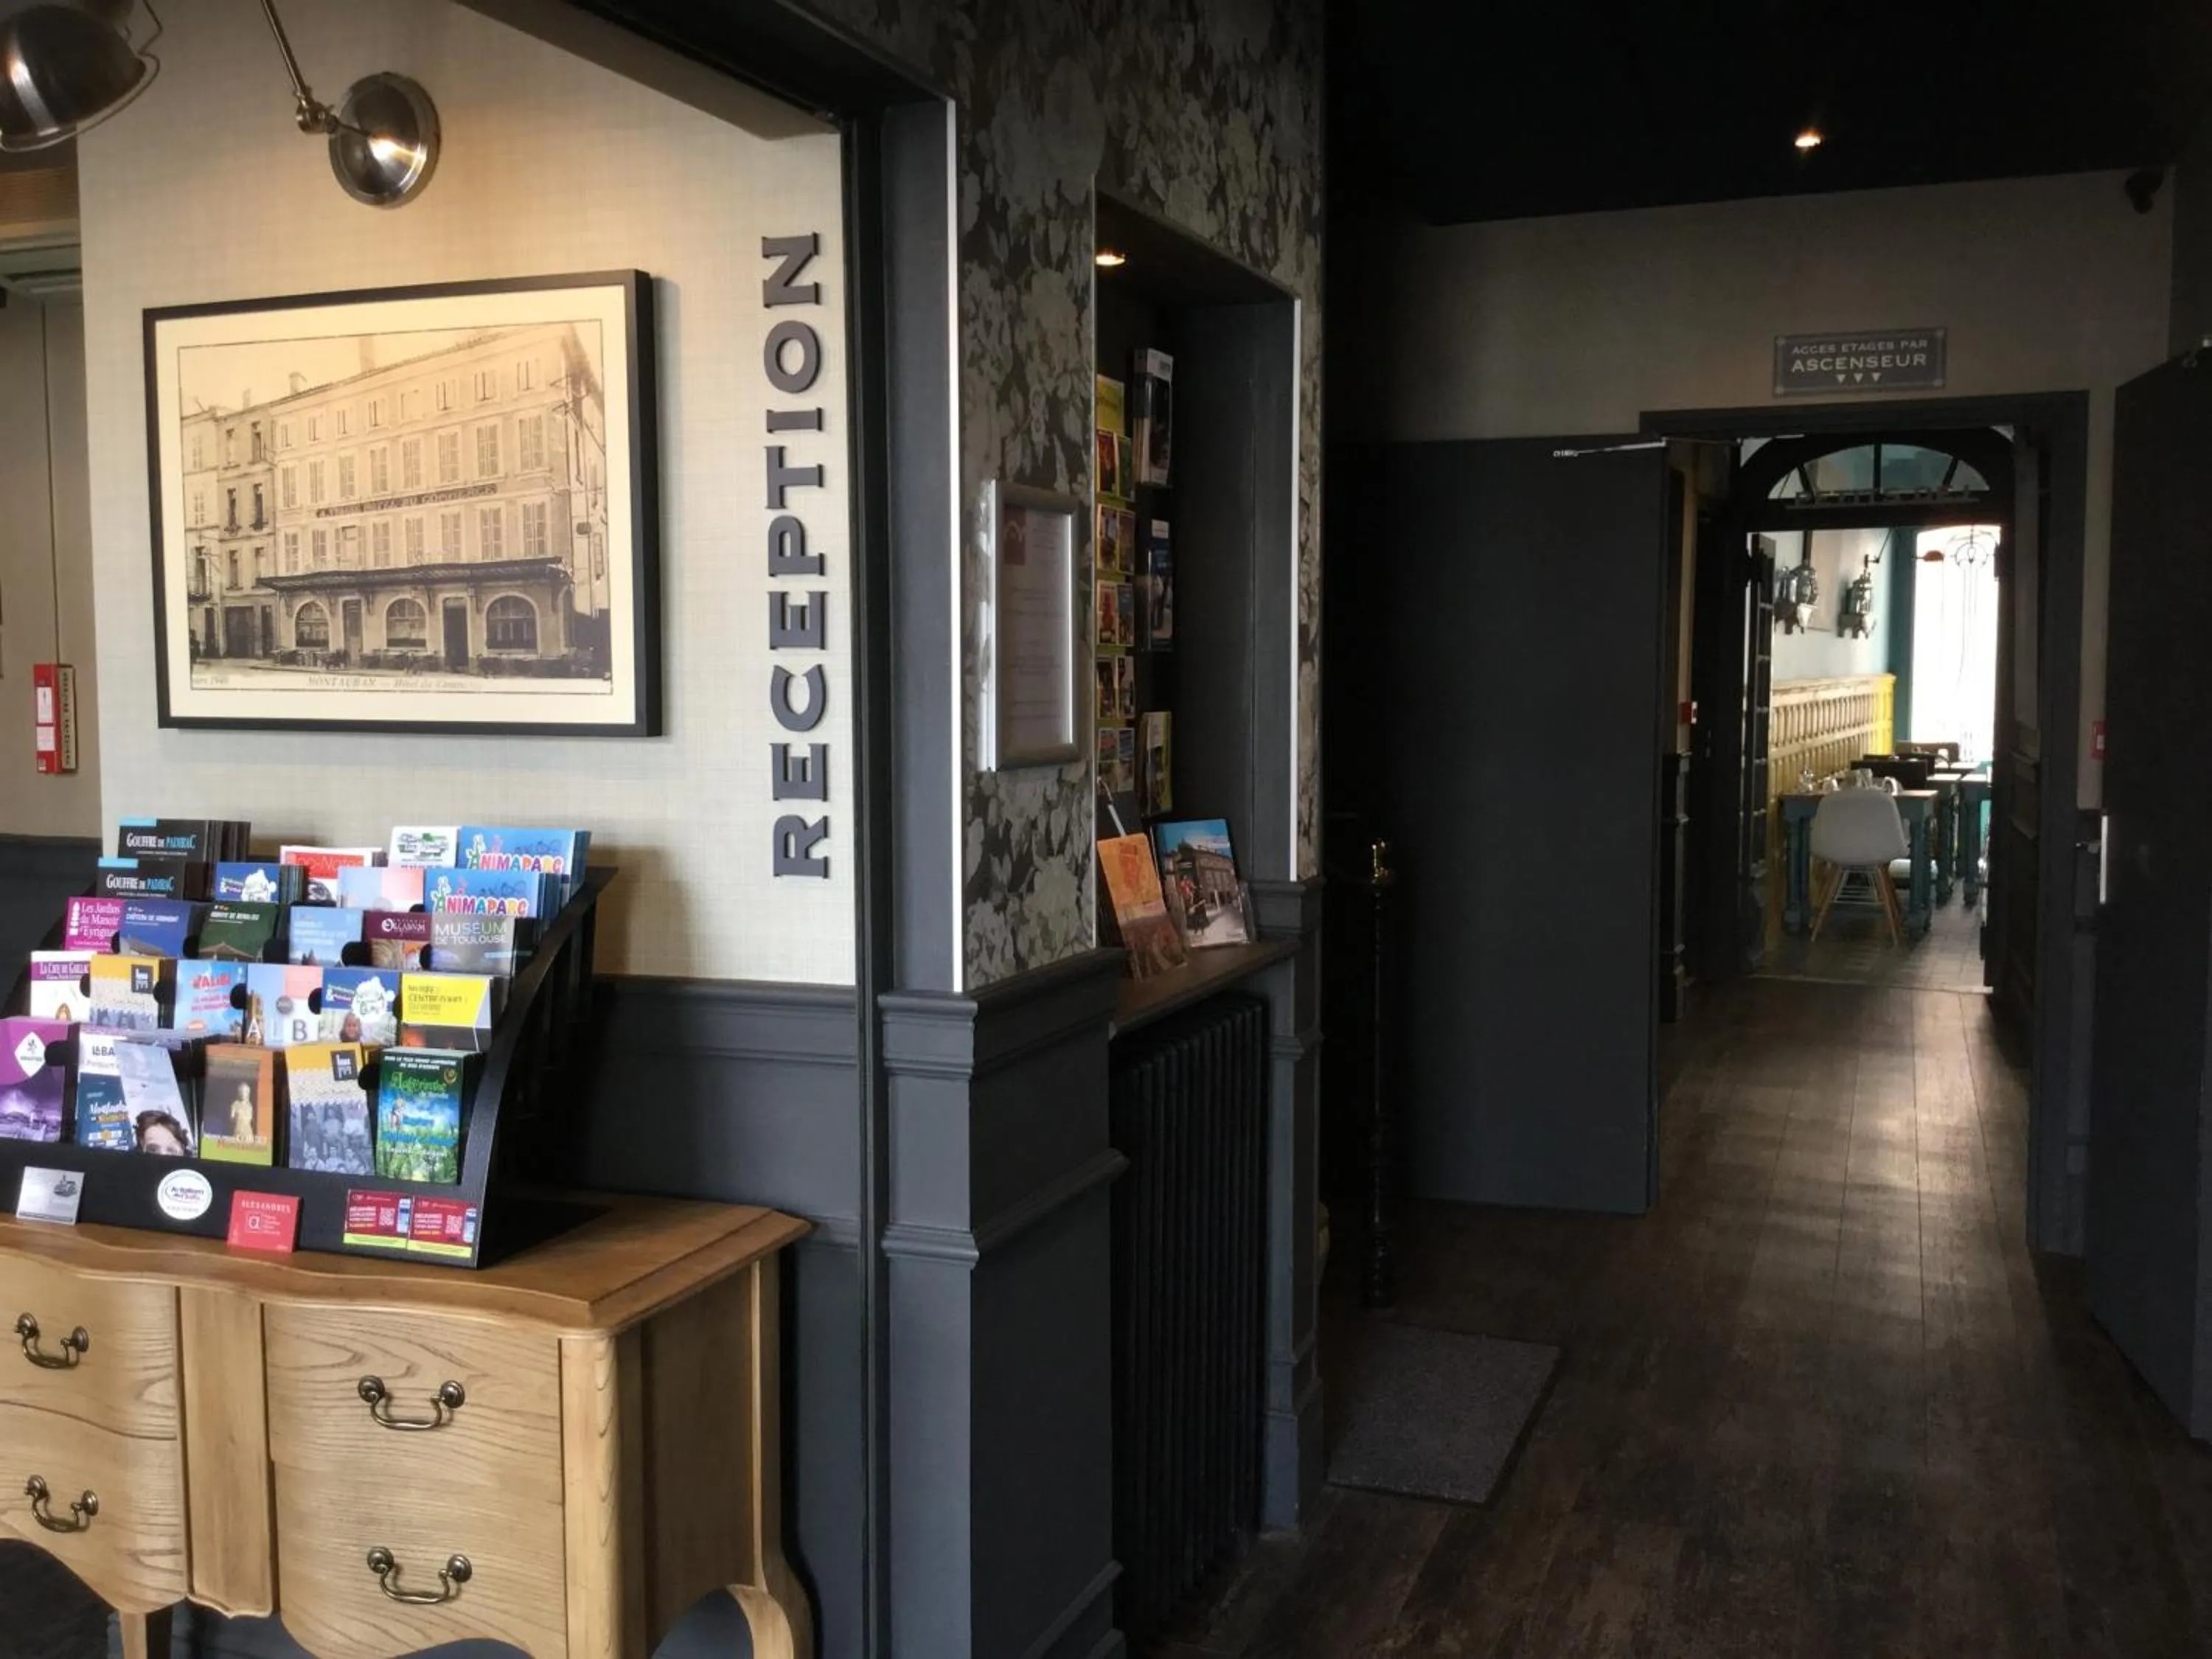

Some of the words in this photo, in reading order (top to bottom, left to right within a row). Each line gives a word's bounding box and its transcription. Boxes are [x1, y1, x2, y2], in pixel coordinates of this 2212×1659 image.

[1792, 343, 1836, 355] ACCES
[1841, 341, 1894, 353] ETAGES
[1900, 339, 1928, 351] PAR
[1791, 353, 1927, 373] ASCENSEUR
[762, 232, 832, 880] RECEPTION
[468, 852, 564, 873] ANIMAPARC
[434, 894, 530, 917] ANIMAPARC
[452, 934, 507, 945] TOULOUSE
